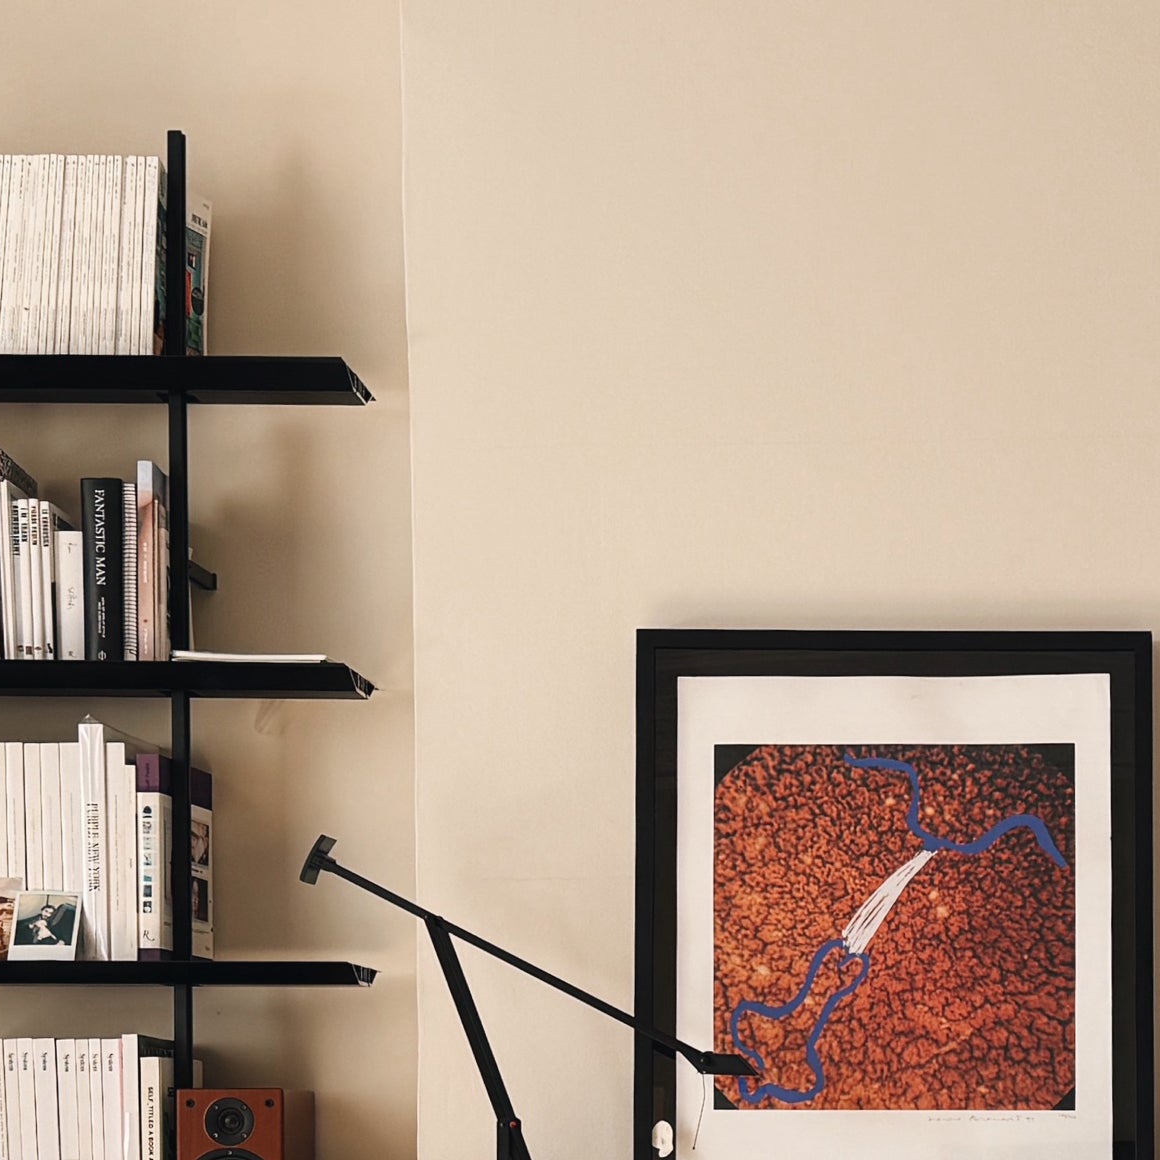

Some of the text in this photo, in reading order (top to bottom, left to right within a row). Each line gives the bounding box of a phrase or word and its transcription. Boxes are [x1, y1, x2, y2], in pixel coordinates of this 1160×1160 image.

[95, 489, 106, 586] FANTASTIC MAN
[89, 867, 100, 892] YORK
[107, 1053, 115, 1072] System
